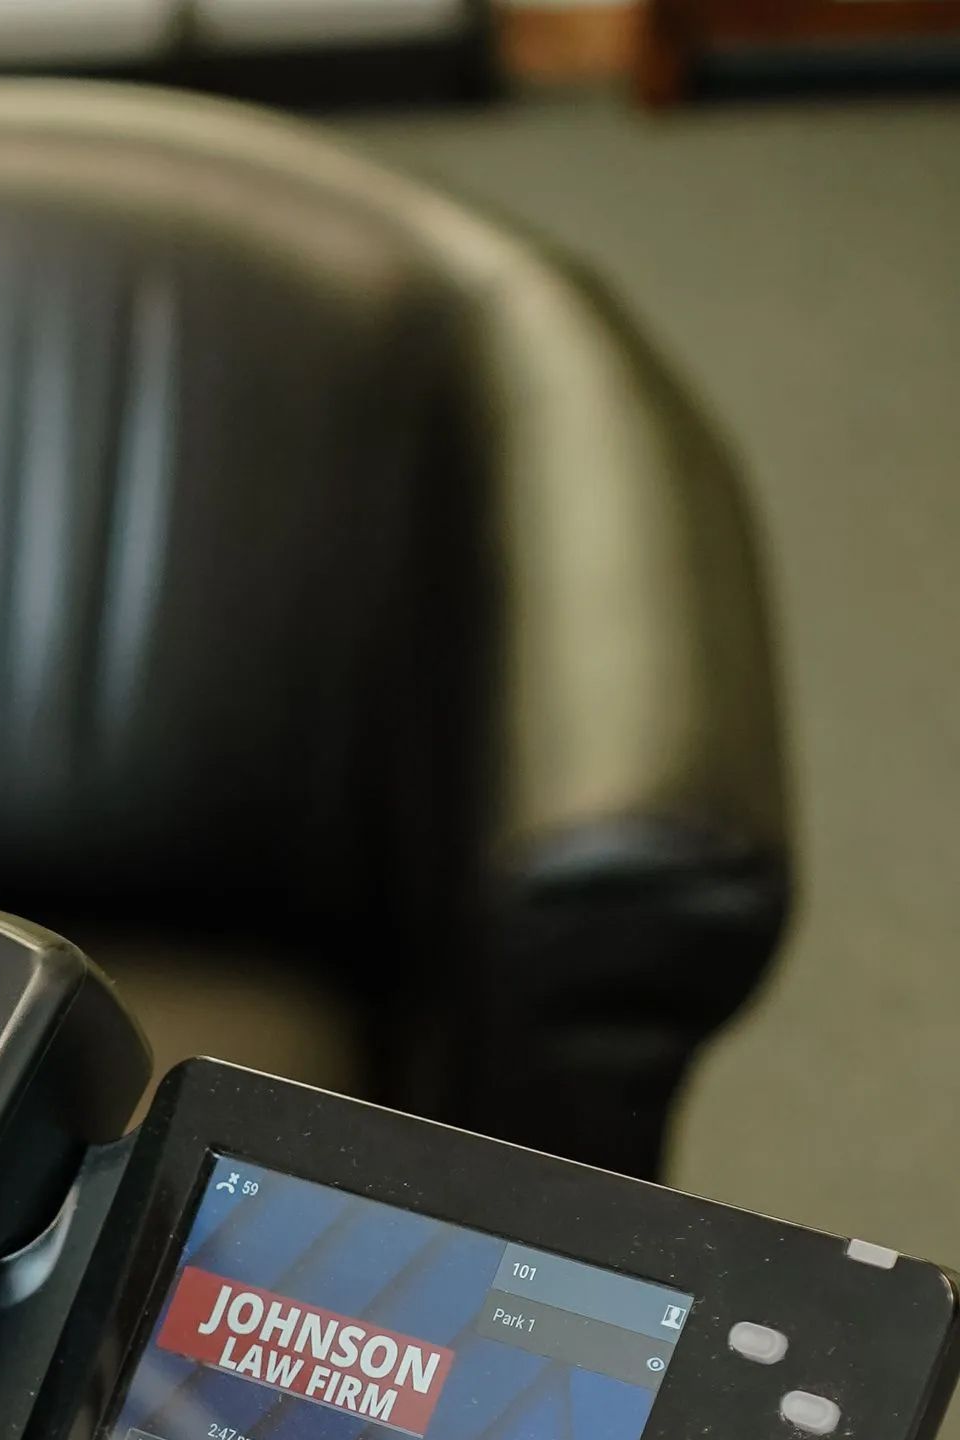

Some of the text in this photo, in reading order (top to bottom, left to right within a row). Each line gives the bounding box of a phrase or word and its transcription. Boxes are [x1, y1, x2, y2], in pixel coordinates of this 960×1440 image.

[242, 1179, 259, 1197] 59
[512, 1262, 537, 1282] 101
[493, 1307, 535, 1333] Park 1
[198, 1284, 441, 1395] JOHNSON
[219, 1336, 399, 1422] LAW FIRM
